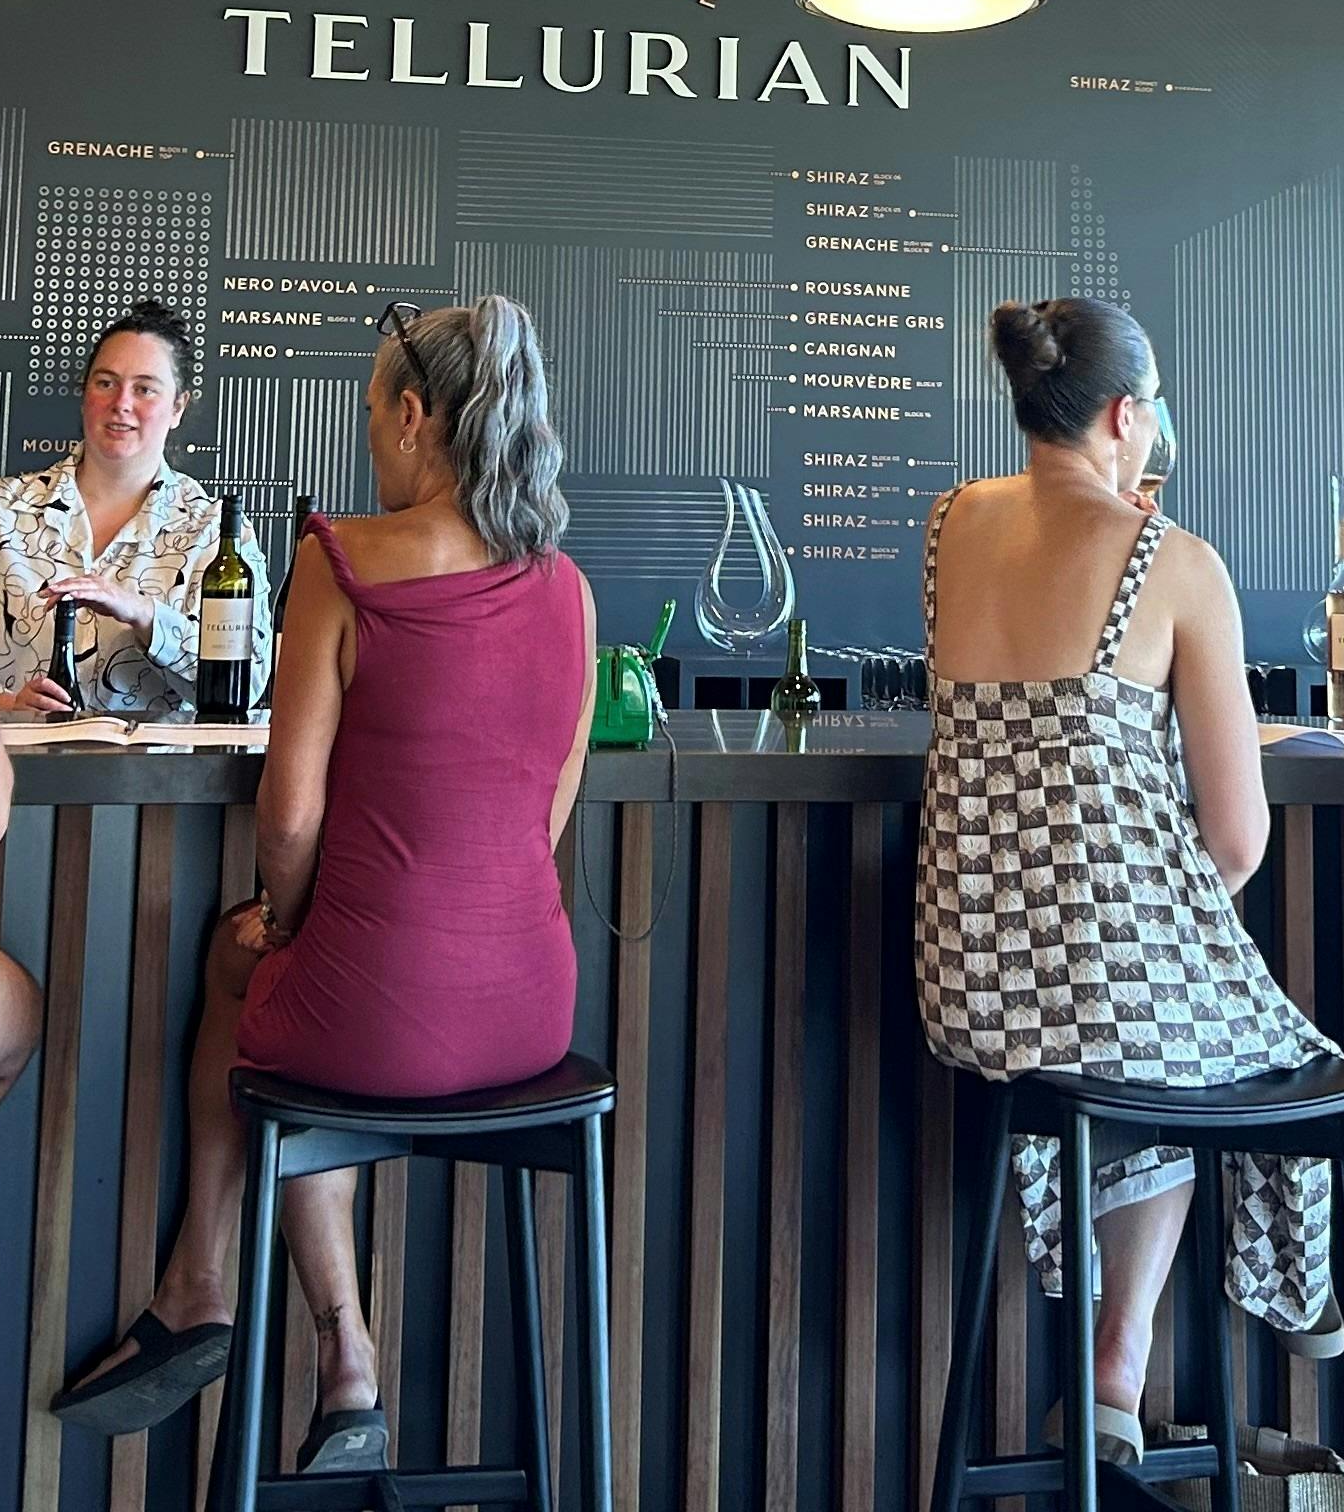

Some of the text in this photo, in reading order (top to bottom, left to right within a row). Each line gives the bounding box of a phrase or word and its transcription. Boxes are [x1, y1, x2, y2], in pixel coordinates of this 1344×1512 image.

[223, 8, 912, 110] TELLURIAN
[1071, 77, 1130, 91] SHIRAZ
[48, 142, 153, 158] GRENACHE
[807, 171, 868, 185] SHIRAZ
[807, 203, 868, 217] SHIRAZ
[806, 237, 898, 251] GRENACHE
[224, 278, 357, 293] NERO D'AVOLA
[806, 282, 910, 297] ROUSSANNE
[222, 311, 322, 325] MARSANNE
[805, 312, 944, 329] GRENACHE GRIS
[220, 345, 276, 357] FIANO
[805, 343, 895, 358] CARIGNAN
[804, 374, 912, 390] MOURVÈDRE
[804, 405, 899, 420] MARSANNE
[804, 453, 867, 467] SHIRAZ
[804, 484, 867, 497] SHIRAZ
[803, 514, 866, 527] SHIRAZ
[803, 546, 866, 559] SHIRAZ
[206, 623, 253, 632] TELLURIA
